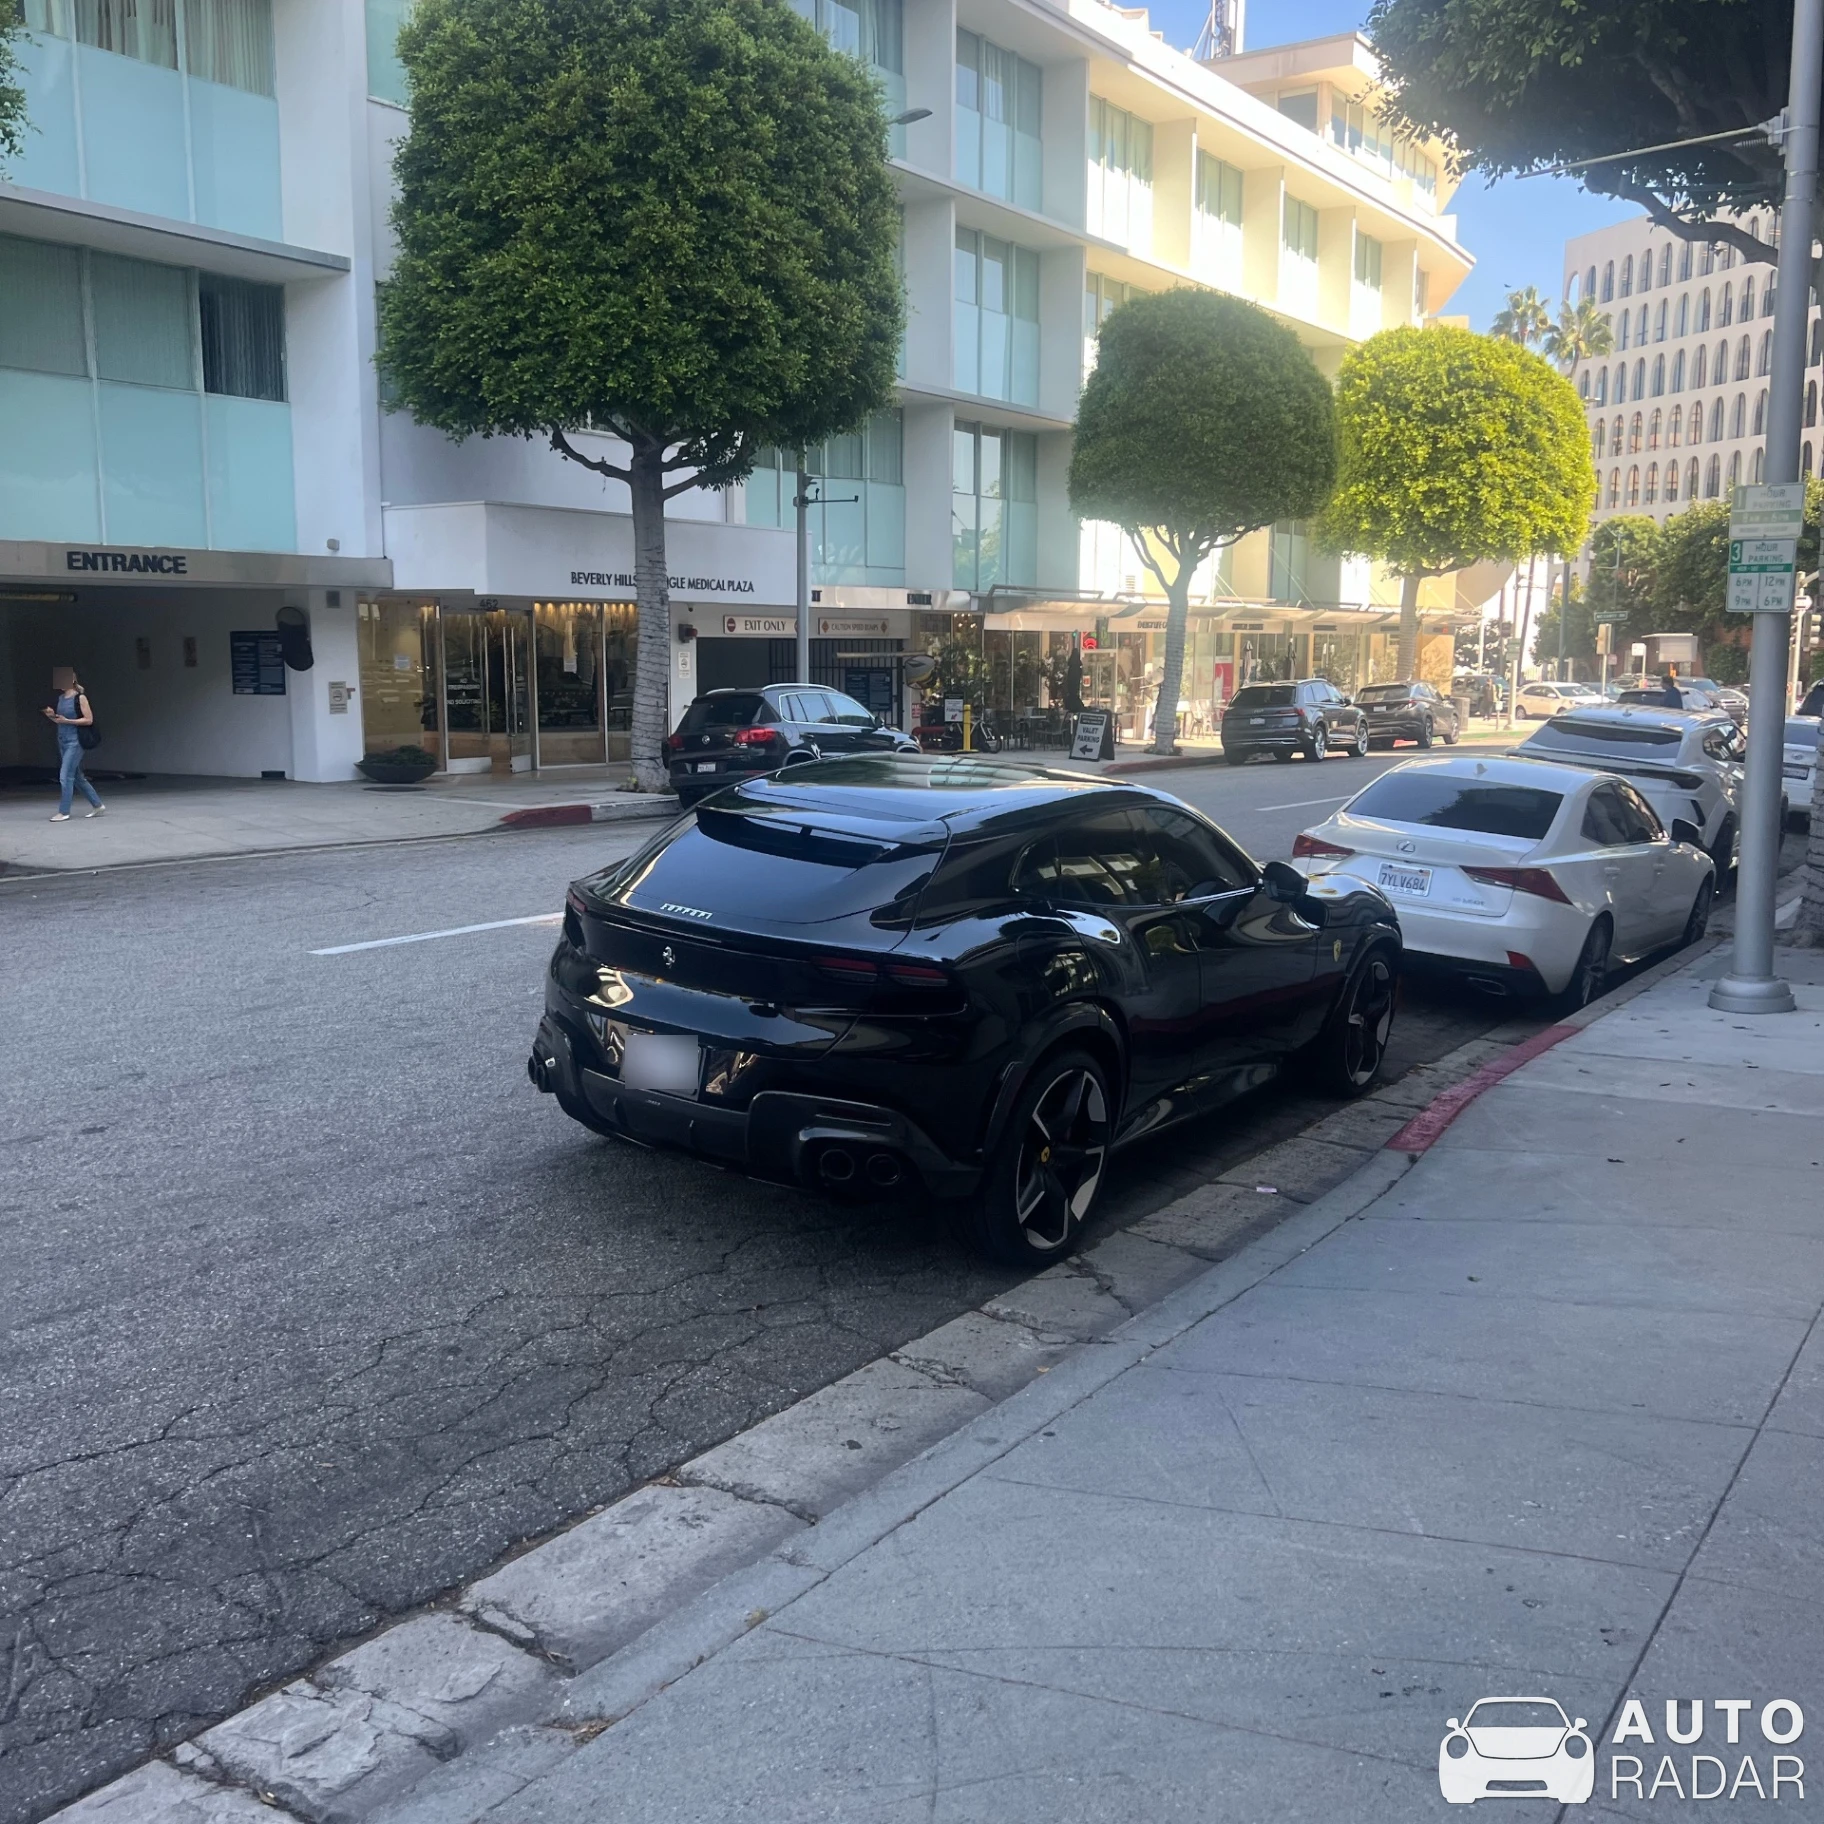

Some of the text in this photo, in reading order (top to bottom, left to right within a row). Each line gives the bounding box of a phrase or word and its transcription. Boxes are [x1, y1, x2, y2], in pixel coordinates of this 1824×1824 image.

[1731, 542, 1741, 562] 3
[1755, 543, 1778, 552] HOUR
[66, 551, 188, 574] ENTRANCE
[1748, 555, 1784, 563] PARKING
[571, 572, 613, 586] BEVERLY
[688, 578, 726, 591] MEDICAL
[727, 579, 755, 592] PLAZA
[744, 620, 787, 632] EXIT ONLY
[1082, 727, 1099, 735] VALET
[1077, 735, 1100, 744] PARKING
